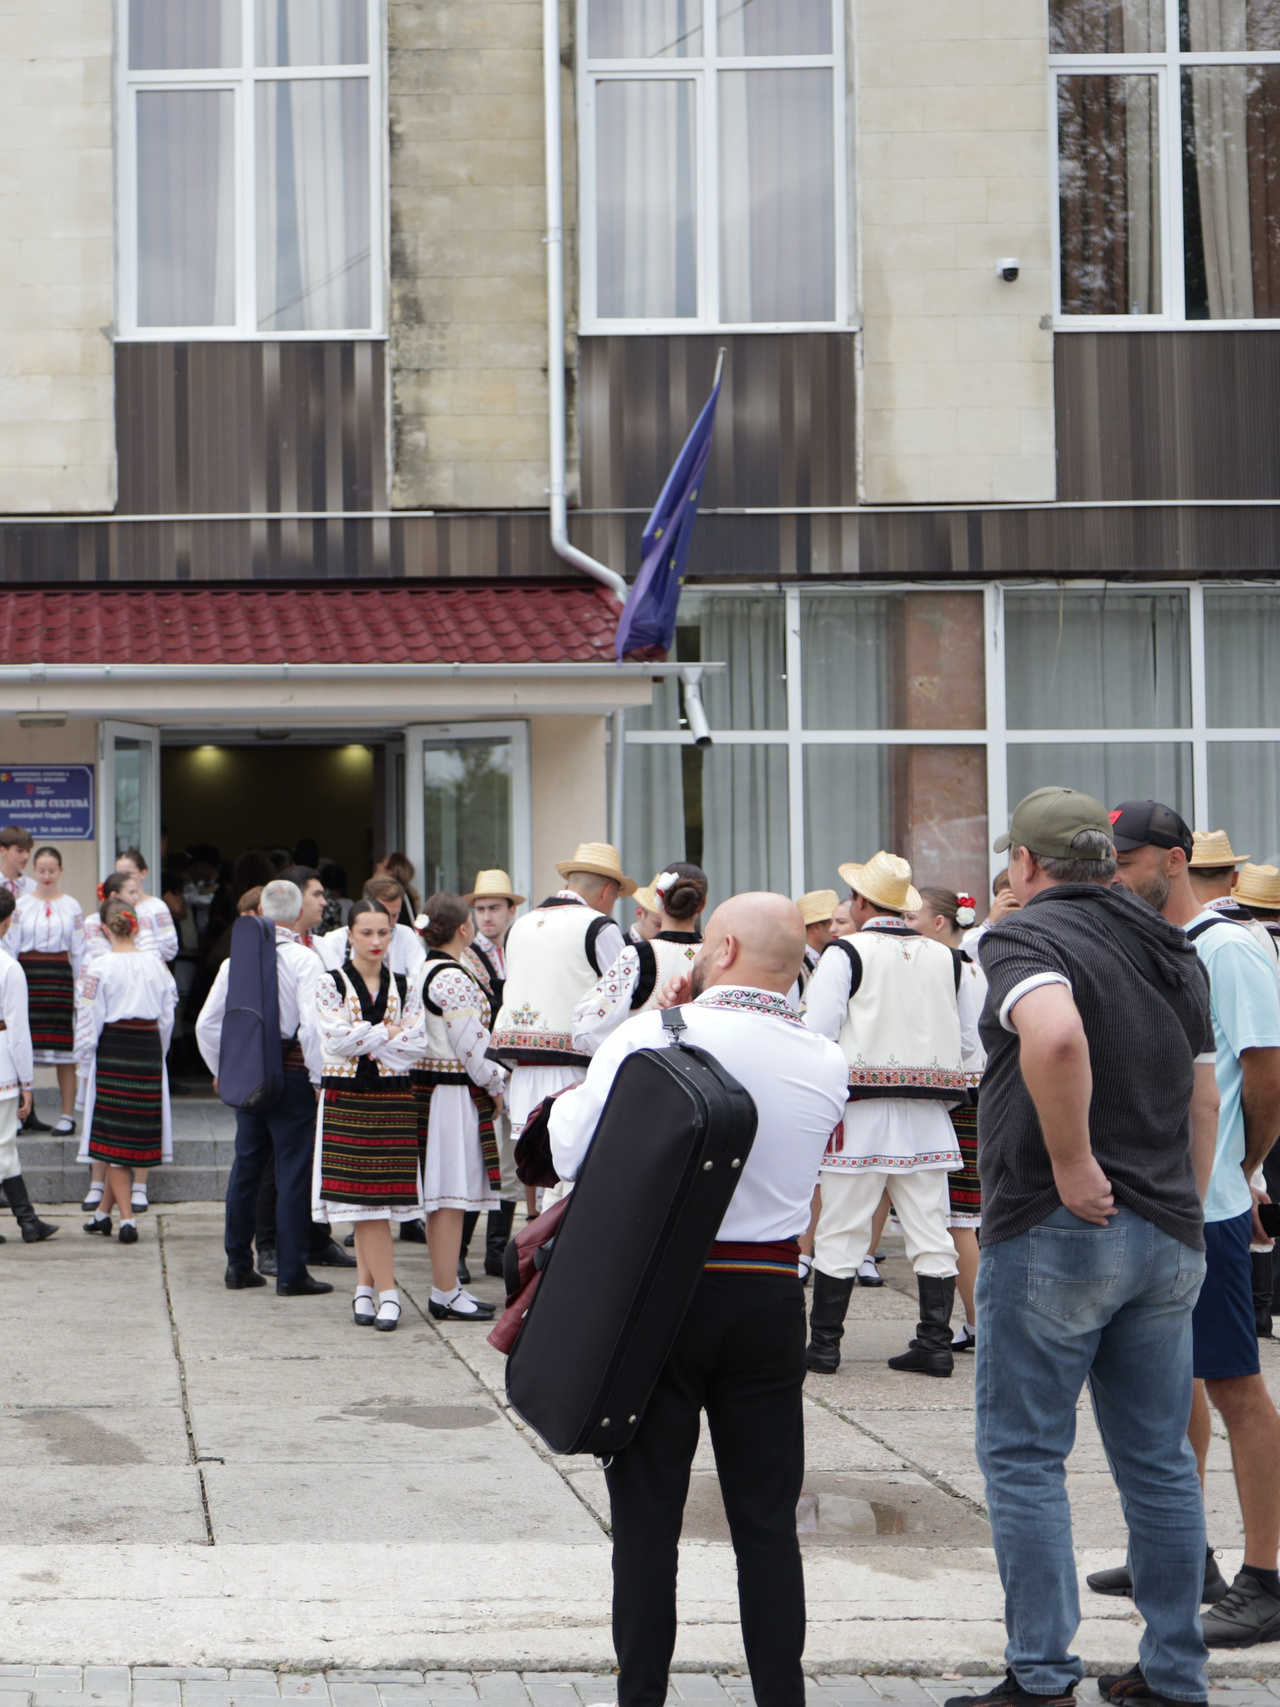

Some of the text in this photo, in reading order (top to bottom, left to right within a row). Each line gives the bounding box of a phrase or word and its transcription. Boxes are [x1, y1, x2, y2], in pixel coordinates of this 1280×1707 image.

[34, 799, 47, 808] DE
[49, 797, 89, 808] CULTURĂ
[44, 812, 71, 820] Ungheni
